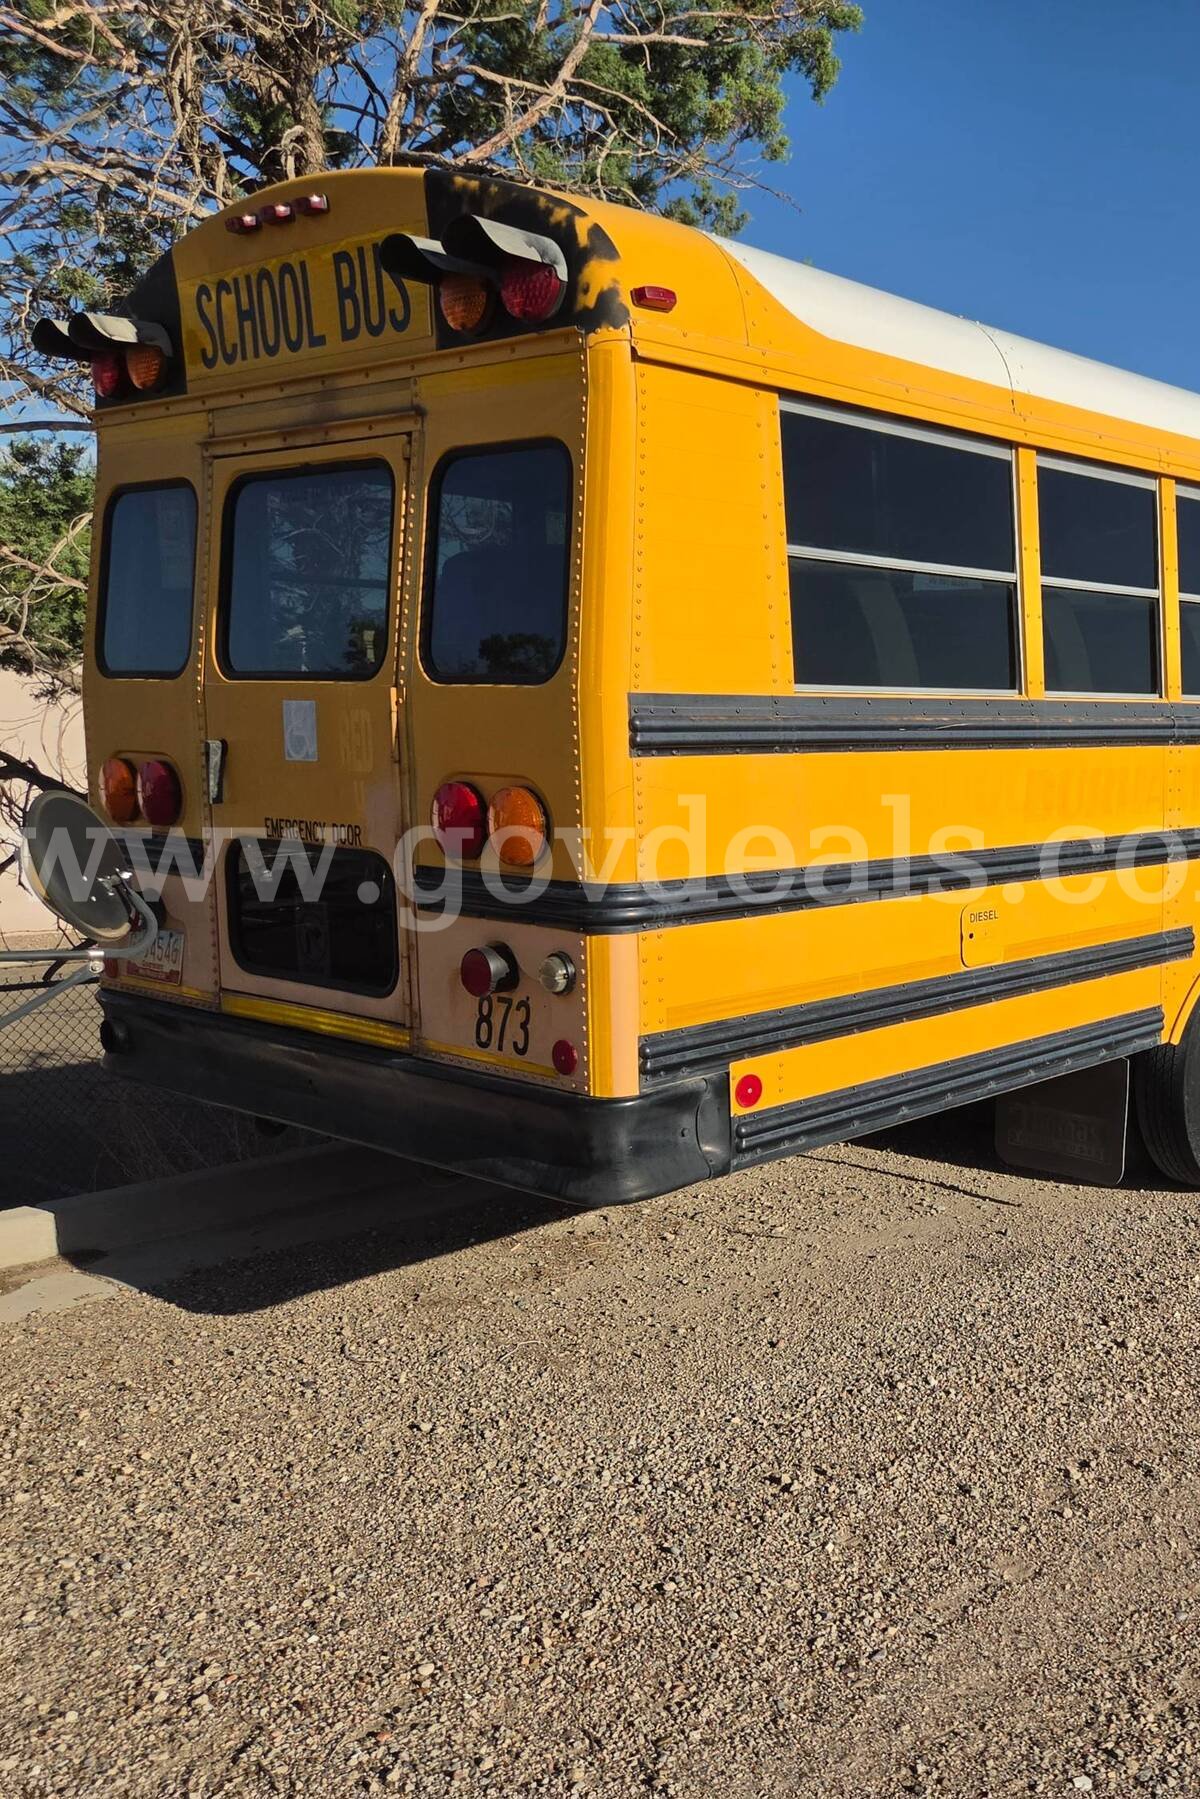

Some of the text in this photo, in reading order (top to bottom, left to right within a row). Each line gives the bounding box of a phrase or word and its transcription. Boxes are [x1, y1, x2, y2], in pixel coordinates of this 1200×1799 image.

[196, 242, 411, 369] SCHOOL BUS
[264, 817, 362, 846] EMERGENCY DOOR
[969, 909, 999, 923] DIESEL
[475, 994, 531, 1056] 873
